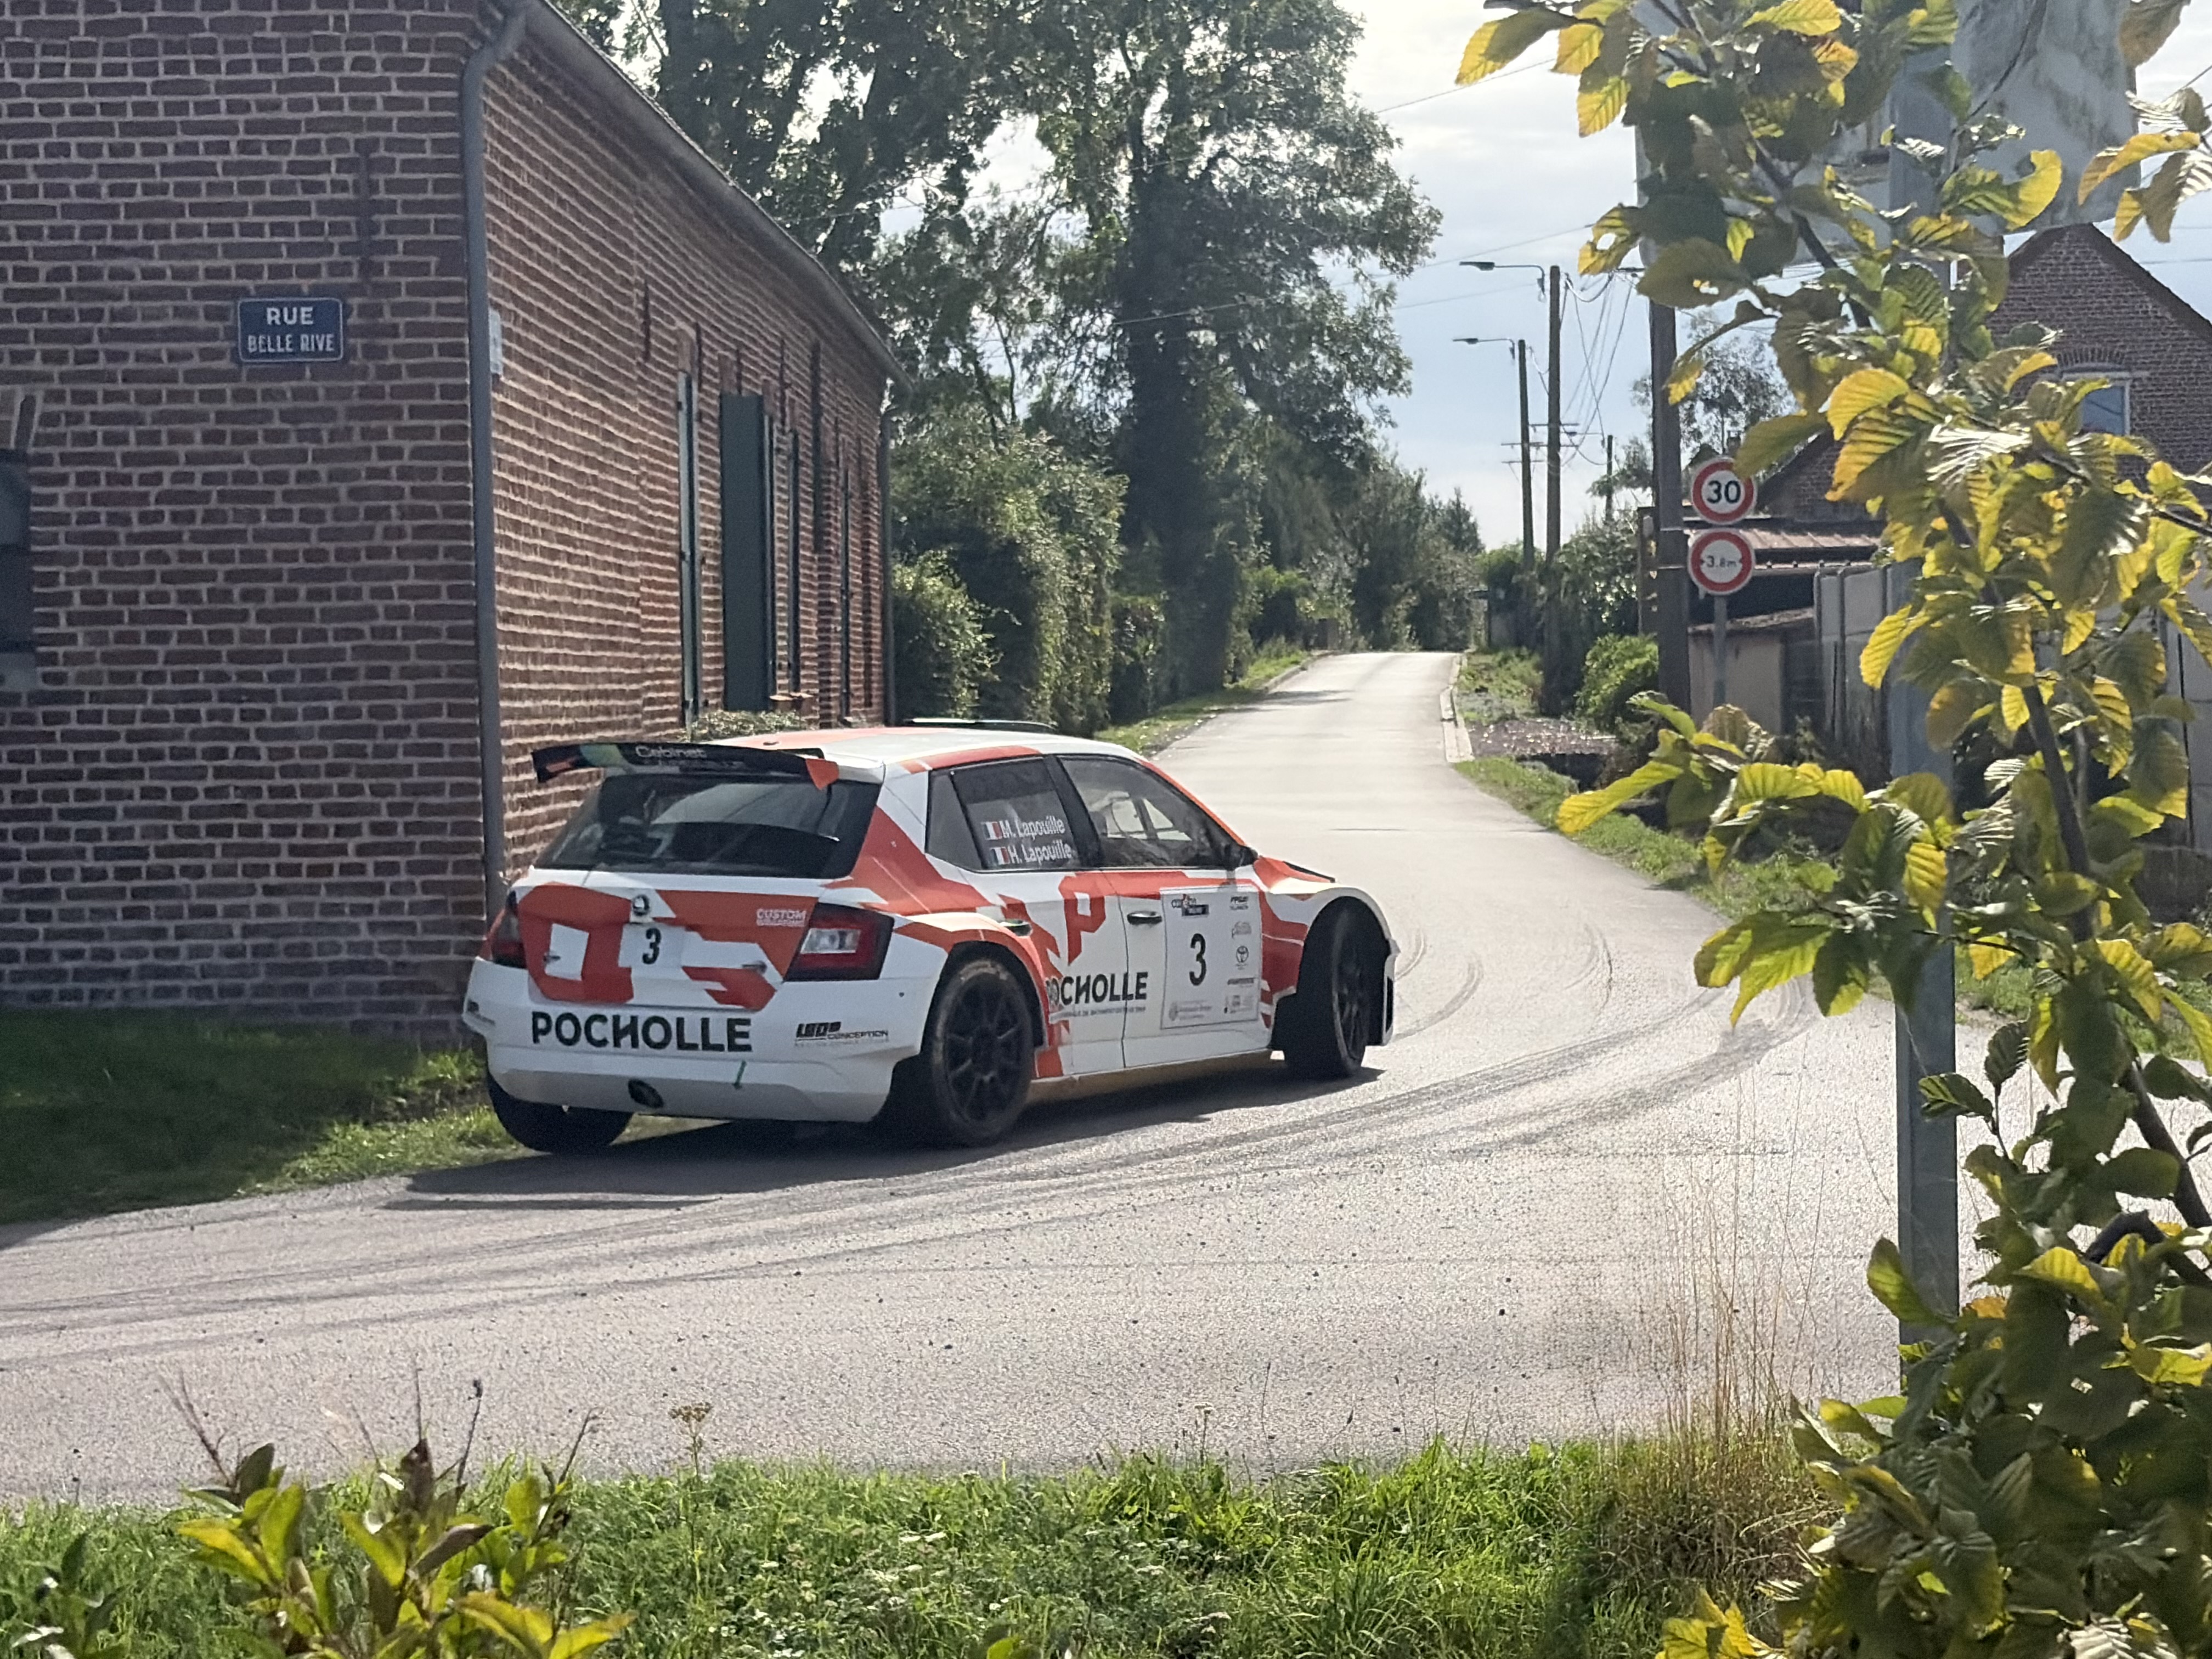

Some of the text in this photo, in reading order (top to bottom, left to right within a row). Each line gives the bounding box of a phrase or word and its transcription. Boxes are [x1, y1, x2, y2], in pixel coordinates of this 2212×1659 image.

[266, 306, 314, 325] RUE
[247, 333, 335, 353] BELLE RIVE
[1707, 480, 1741, 504] 30
[999, 815, 1066, 841] M. Lapouille
[1007, 839, 1072, 866] H. Lapouille
[641, 927, 662, 965] 3
[1188, 933, 1207, 986] 3
[531, 1011, 753, 1053] POCHOLLE
